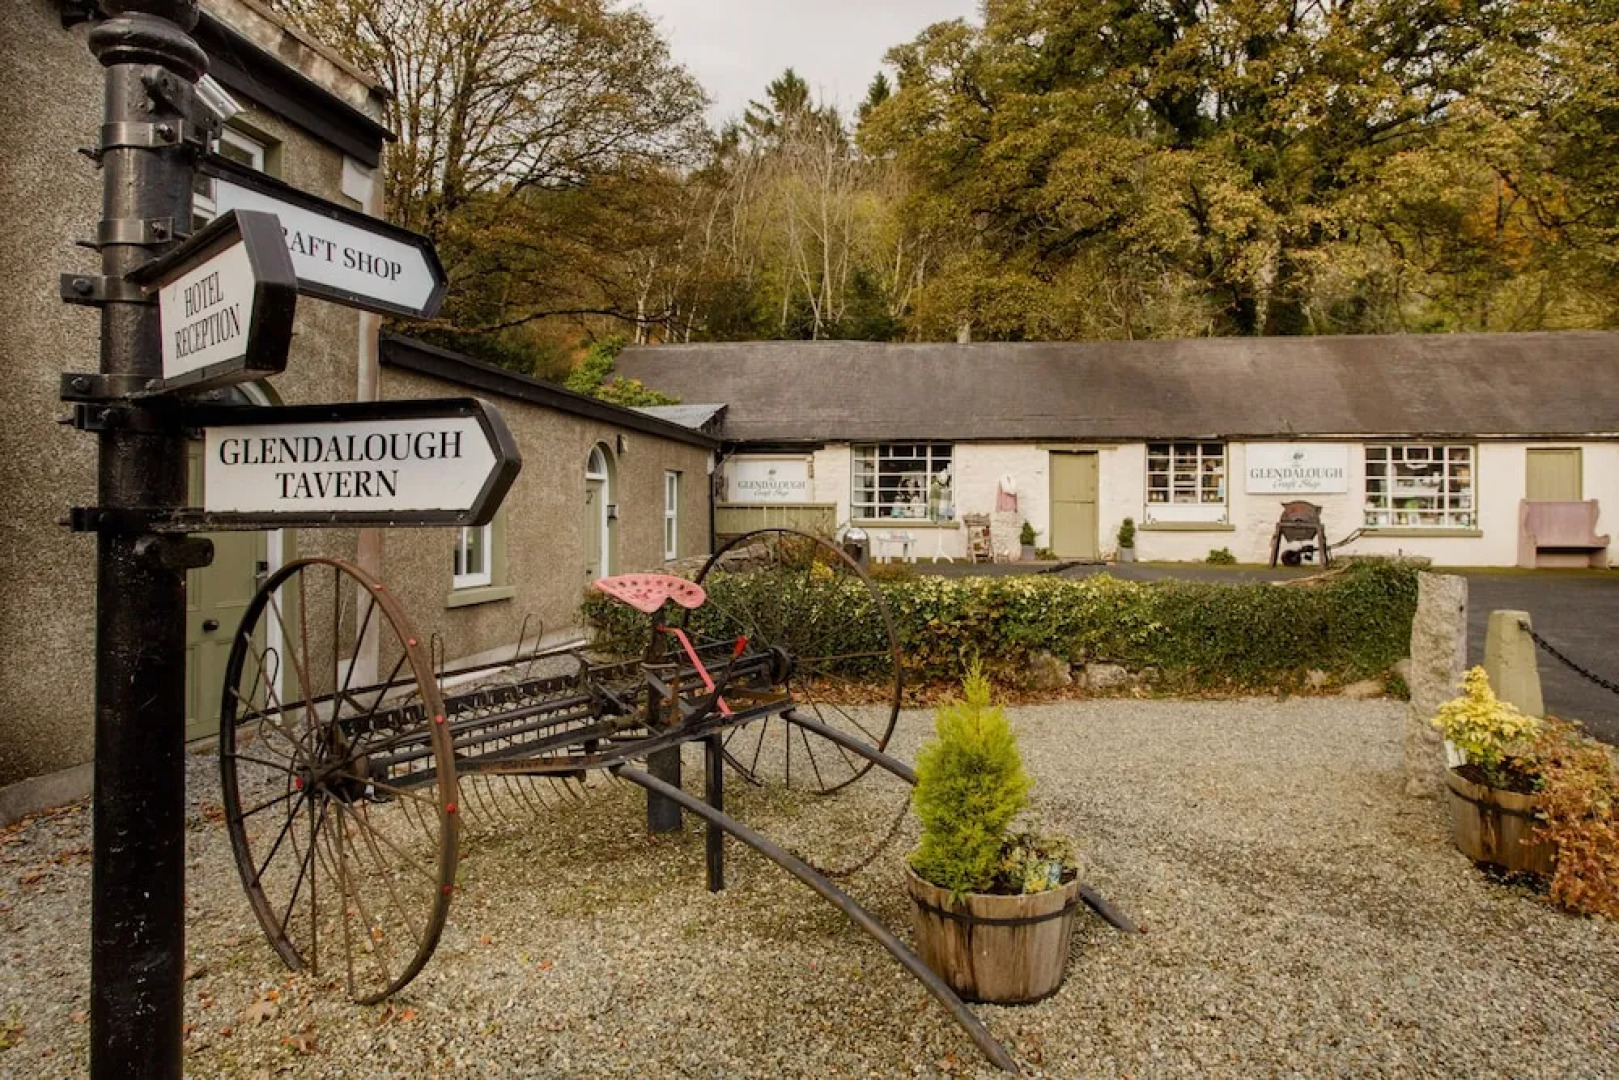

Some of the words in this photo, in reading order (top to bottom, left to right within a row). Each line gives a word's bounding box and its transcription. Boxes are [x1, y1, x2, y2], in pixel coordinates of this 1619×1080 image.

[343, 247, 402, 281] SHOP
[184, 271, 224, 318] HOTEL
[175, 303, 240, 359] RECEPTION
[219, 431, 463, 465] GLENDALOUGH
[275, 470, 399, 499] TAVERN
[738, 480, 806, 490] GLENDALOUGH
[1250, 467, 1343, 479] GLENDALOUGH
